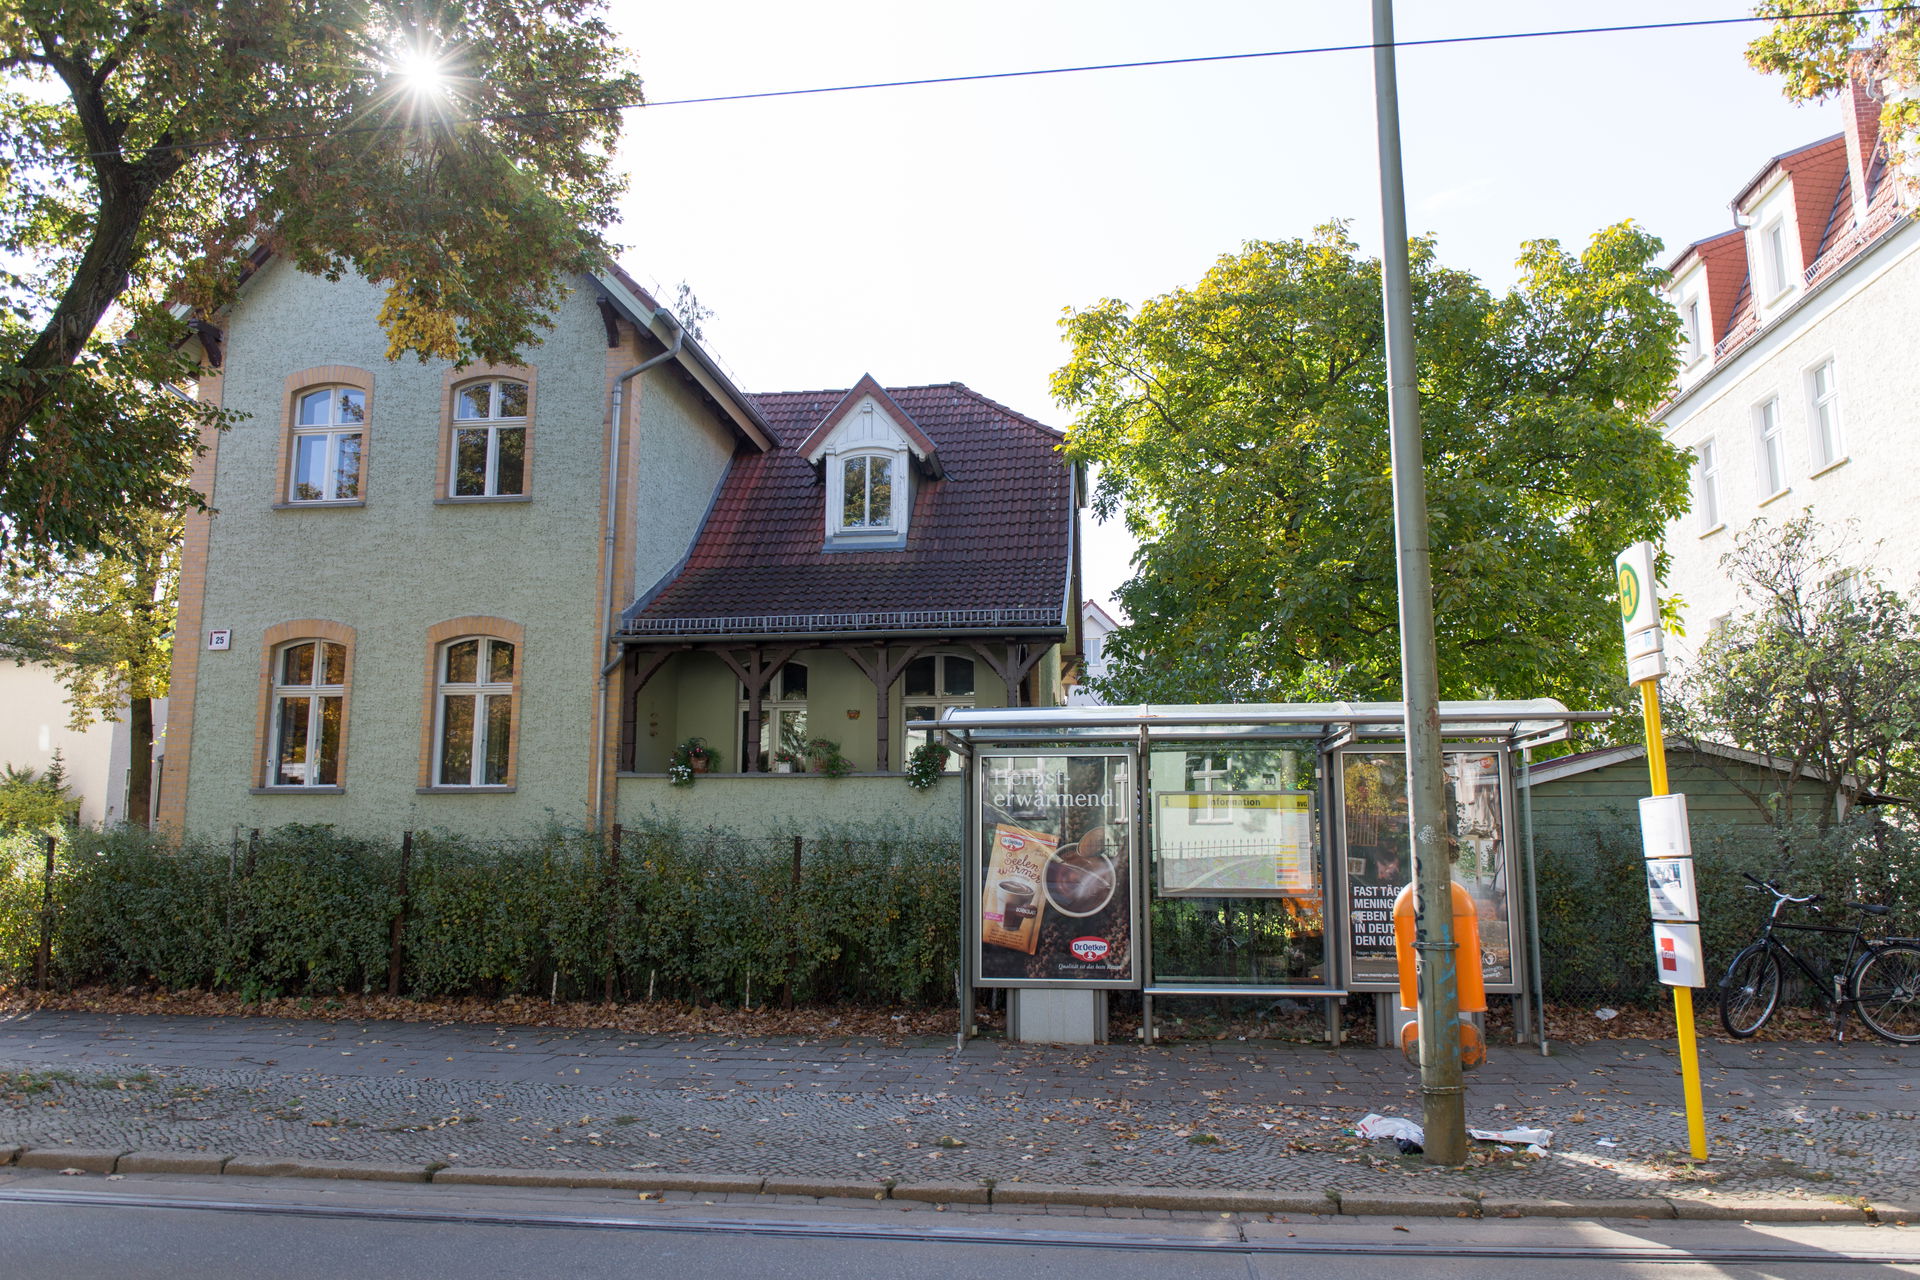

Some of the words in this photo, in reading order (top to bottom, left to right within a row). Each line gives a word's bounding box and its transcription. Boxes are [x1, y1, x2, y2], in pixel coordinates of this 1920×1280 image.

[1621, 575, 1632, 610] H
[215, 636, 225, 645] 25
[994, 769, 1071, 786] Herbst-
[993, 788, 1120, 807] erwärmend.
[1208, 797, 1260, 806] nformation
[1004, 852, 1040, 872] Seelen
[1353, 886, 1378, 897] FAST
[1380, 884, 1403, 897] TÄG
[1354, 911, 1387, 921] EBEN
[1355, 923, 1366, 933] IN
[1355, 935, 1376, 946] DEN
